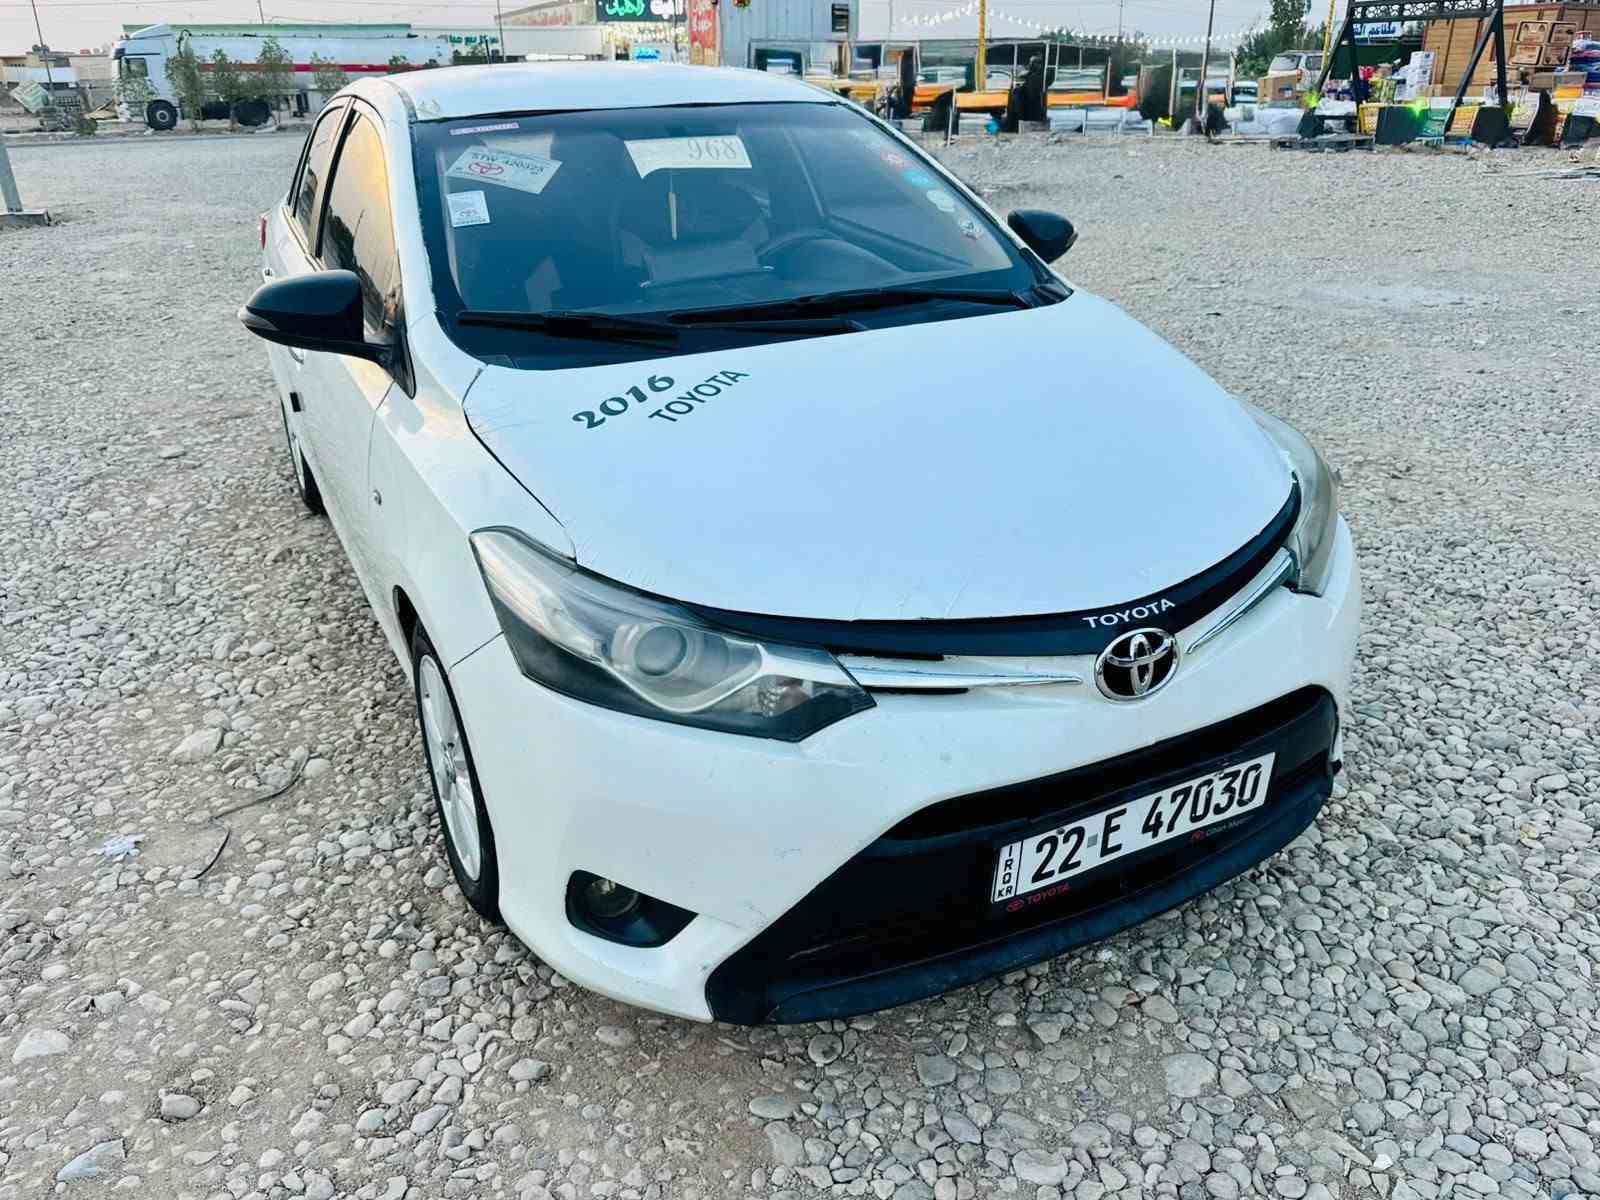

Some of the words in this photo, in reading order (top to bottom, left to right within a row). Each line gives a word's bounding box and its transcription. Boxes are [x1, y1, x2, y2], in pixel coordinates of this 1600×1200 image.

[572, 374, 675, 429] 2016
[648, 370, 750, 423] TOYOTA
[1081, 598, 1176, 629] TOYOTA
[1031, 825, 1086, 884] 22
[1099, 807, 1127, 858] E
[1141, 762, 1262, 839] 47030
[998, 885, 1013, 899] KR
[1026, 882, 1071, 904] TOYOTA
